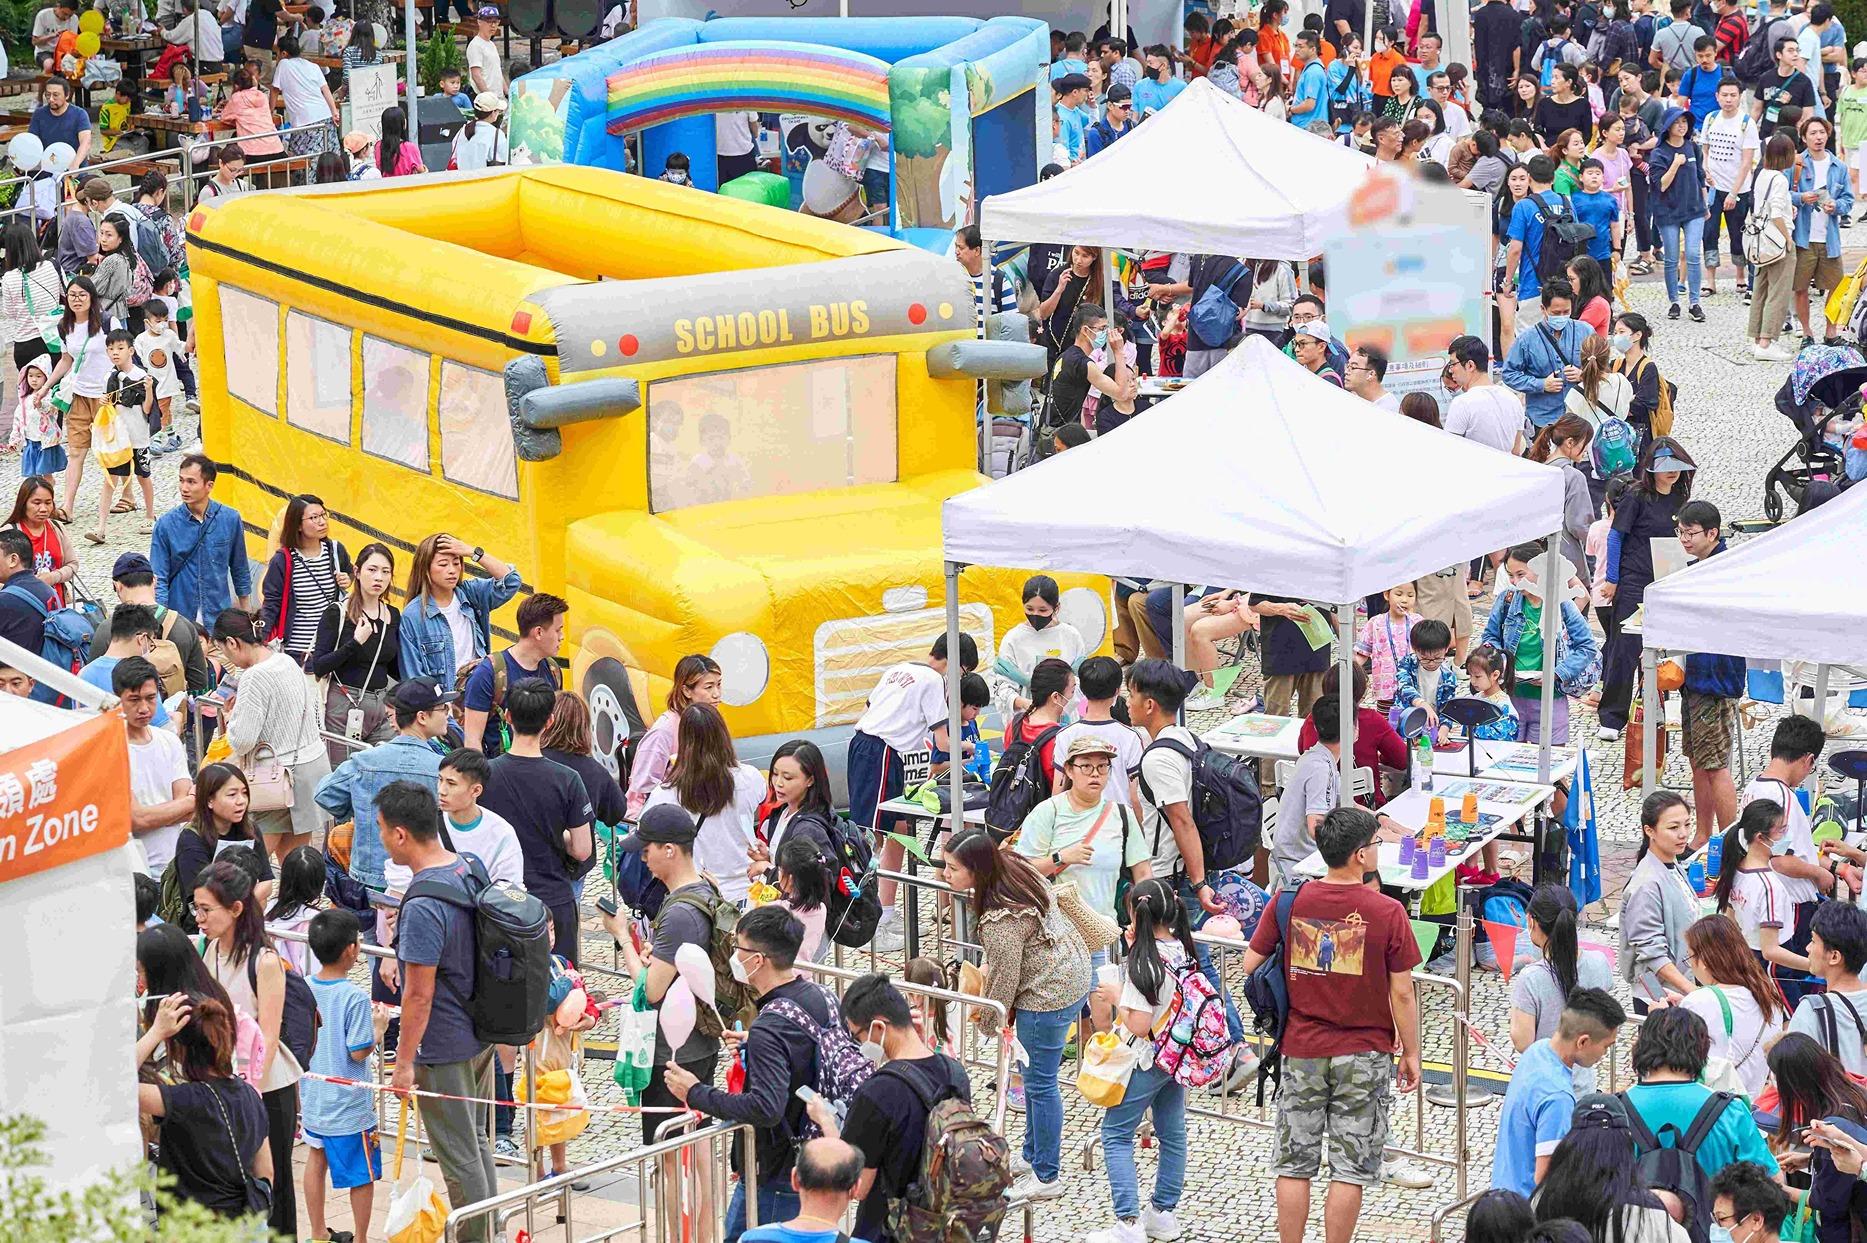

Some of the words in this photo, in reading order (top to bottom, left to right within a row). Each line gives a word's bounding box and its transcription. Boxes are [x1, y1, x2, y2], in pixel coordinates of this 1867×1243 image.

[674, 308, 793, 353] SCHOOL
[809, 300, 870, 339] BUS
[23, 803, 99, 857] Zone
[1240, 880, 1263, 912] CHELSEA
